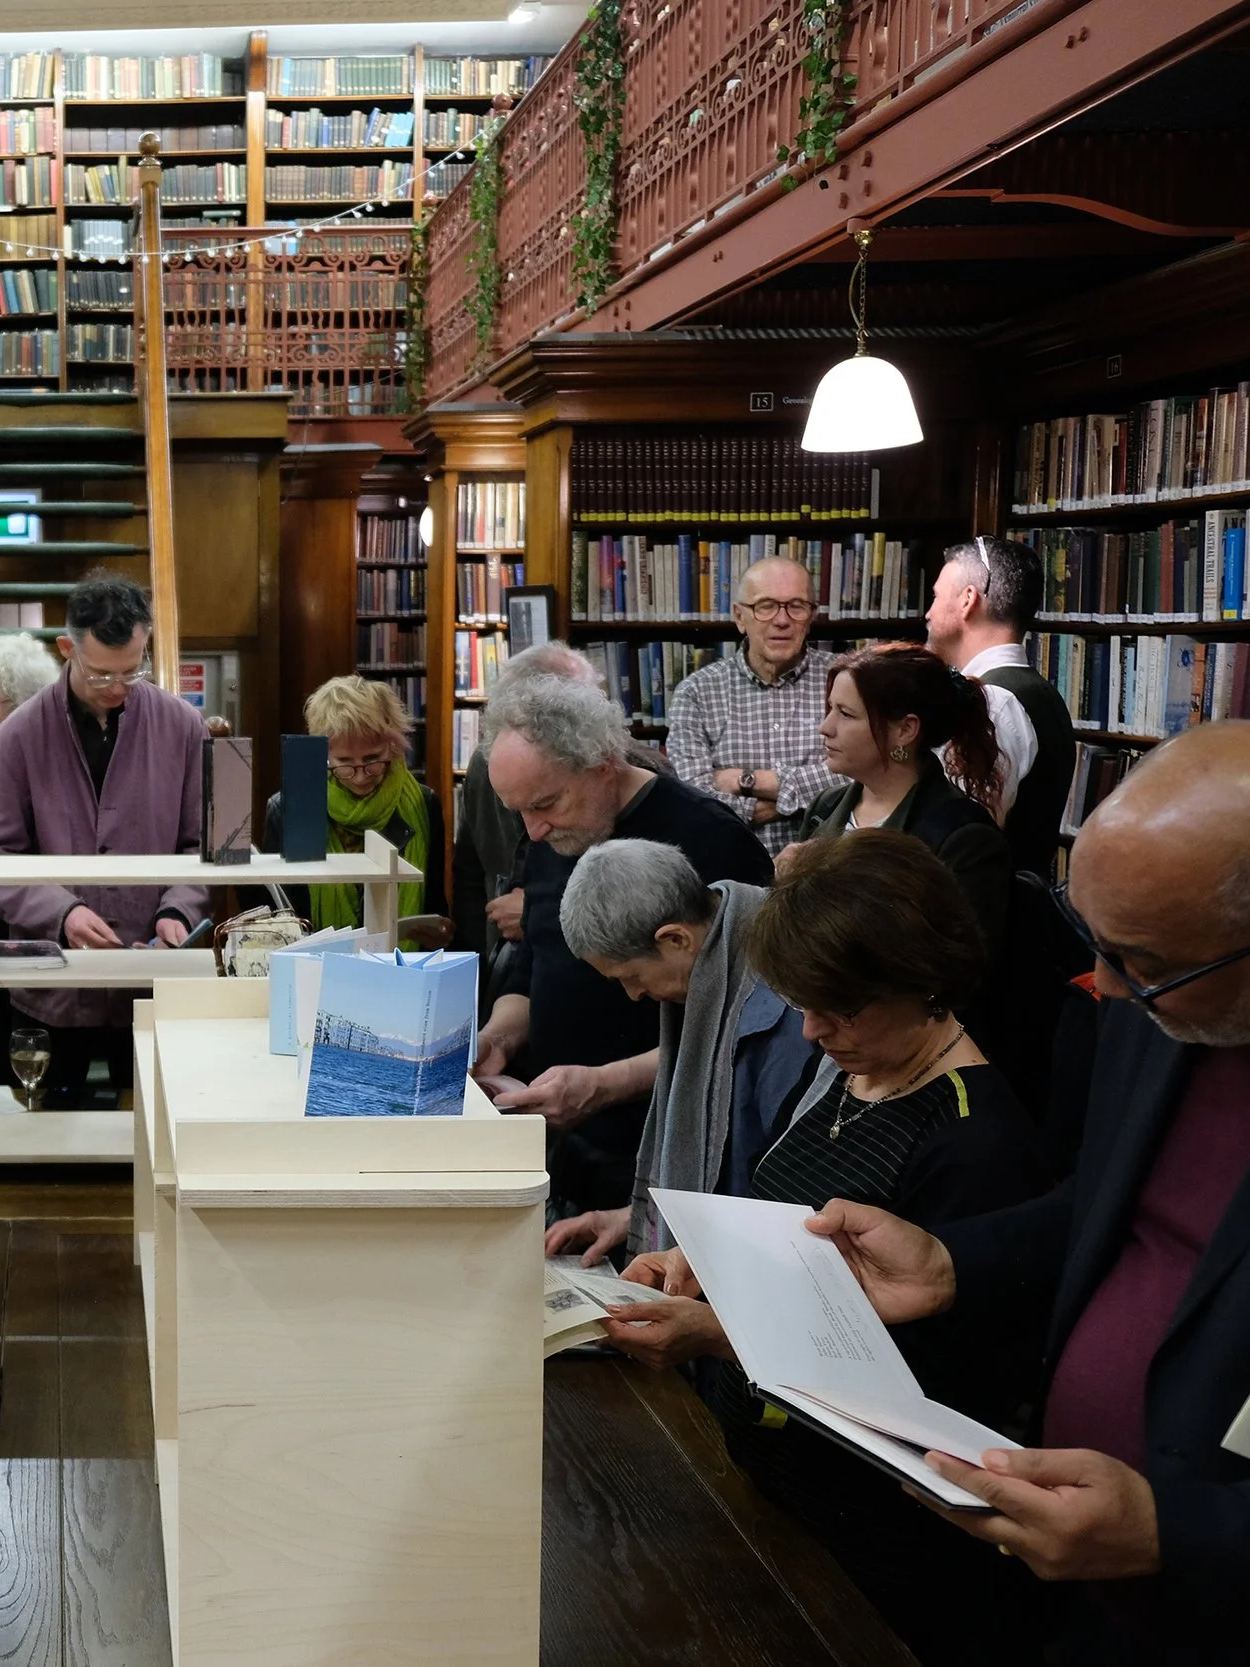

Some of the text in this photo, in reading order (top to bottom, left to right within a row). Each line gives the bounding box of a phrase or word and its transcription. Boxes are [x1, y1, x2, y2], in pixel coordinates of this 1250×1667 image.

[756, 397, 769, 408] 15
[1205, 521, 1216, 584] ANCESTRAL TRAILS
